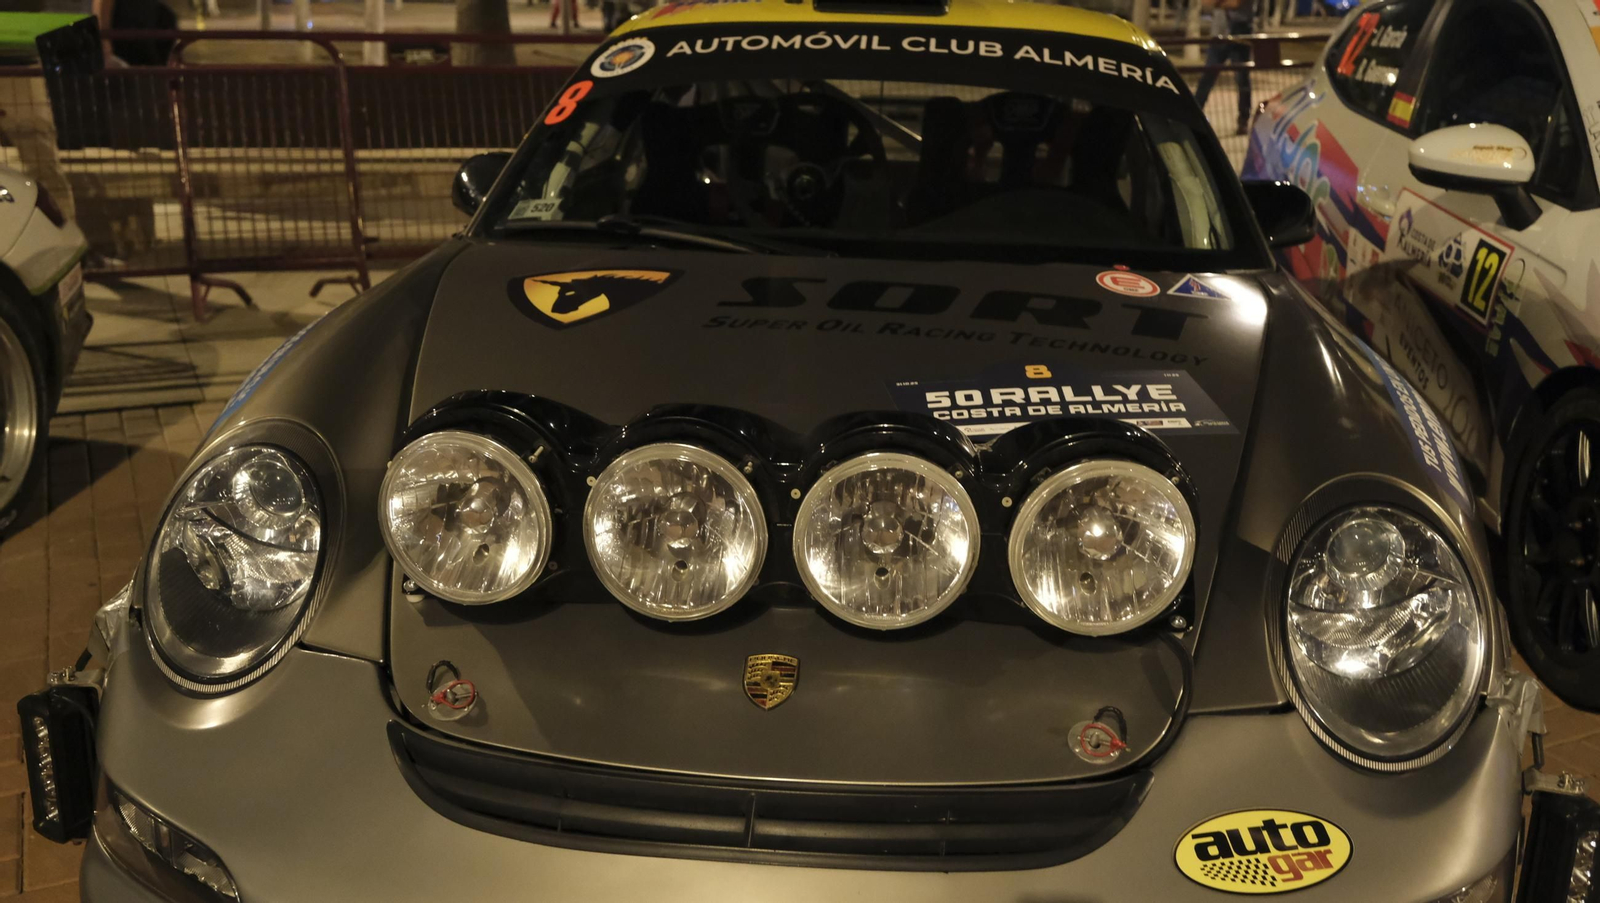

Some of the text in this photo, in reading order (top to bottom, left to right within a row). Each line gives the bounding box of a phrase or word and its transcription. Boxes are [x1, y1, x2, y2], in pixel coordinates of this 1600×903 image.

[666, 31, 891, 57] AUTOMÓVIL
[901, 36, 1003, 57] CLUB
[1013, 45, 1180, 95] ALMERÍA
[543, 80, 594, 125] 8
[1467, 246, 1500, 312] 12
[716, 276, 1209, 341] SORT
[703, 315, 1209, 368] SUPER OIL RACING TECHNOLOGY
[1024, 364, 1053, 380] 8
[925, 384, 1178, 409] 50 RALLYE
[932, 400, 1187, 421] COSTA DE ALMERÍA
[1191, 818, 1332, 862] auto
[1267, 849, 1334, 883] gar
